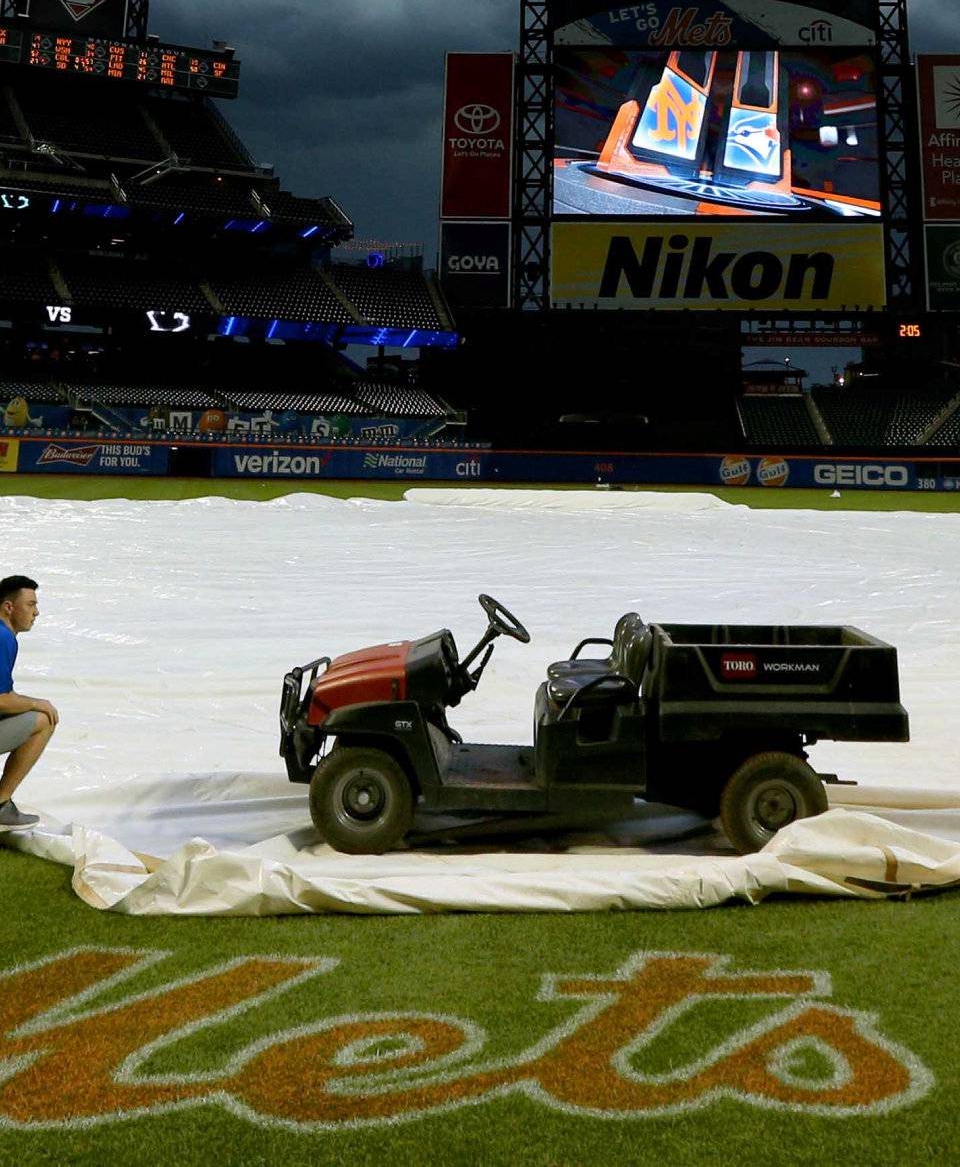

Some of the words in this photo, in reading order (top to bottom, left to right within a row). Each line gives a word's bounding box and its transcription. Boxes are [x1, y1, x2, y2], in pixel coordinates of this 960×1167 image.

[608, 3, 657, 23] LET'S
[636, 17, 660, 32] GO
[648, 7, 734, 46] Mets
[798, 23, 833, 42] citi
[56, 61, 67, 70] SD
[214, 69, 224, 77] SF
[448, 138, 505, 150] TOYOTA
[447, 255, 499, 271] GOYA
[598, 235, 836, 300] Nikon
[899, 325, 920, 337] 2:05
[43, 447, 93, 460] Budweiser
[101, 445, 122, 455] THIS
[124, 445, 151, 456] BUD'S
[100, 456, 118, 467] FOR
[120, 457, 141, 467] YOU.
[234, 450, 321, 475] verizon
[378, 453, 427, 468] National
[456, 459, 481, 476] citi
[722, 465, 751, 479] Gulf
[759, 465, 786, 479] Gulf
[813, 464, 909, 486] GEICO
[917, 478, 936, 489] 380
[723, 660, 755, 671] TORO
[763, 662, 820, 672] WORKMAN
